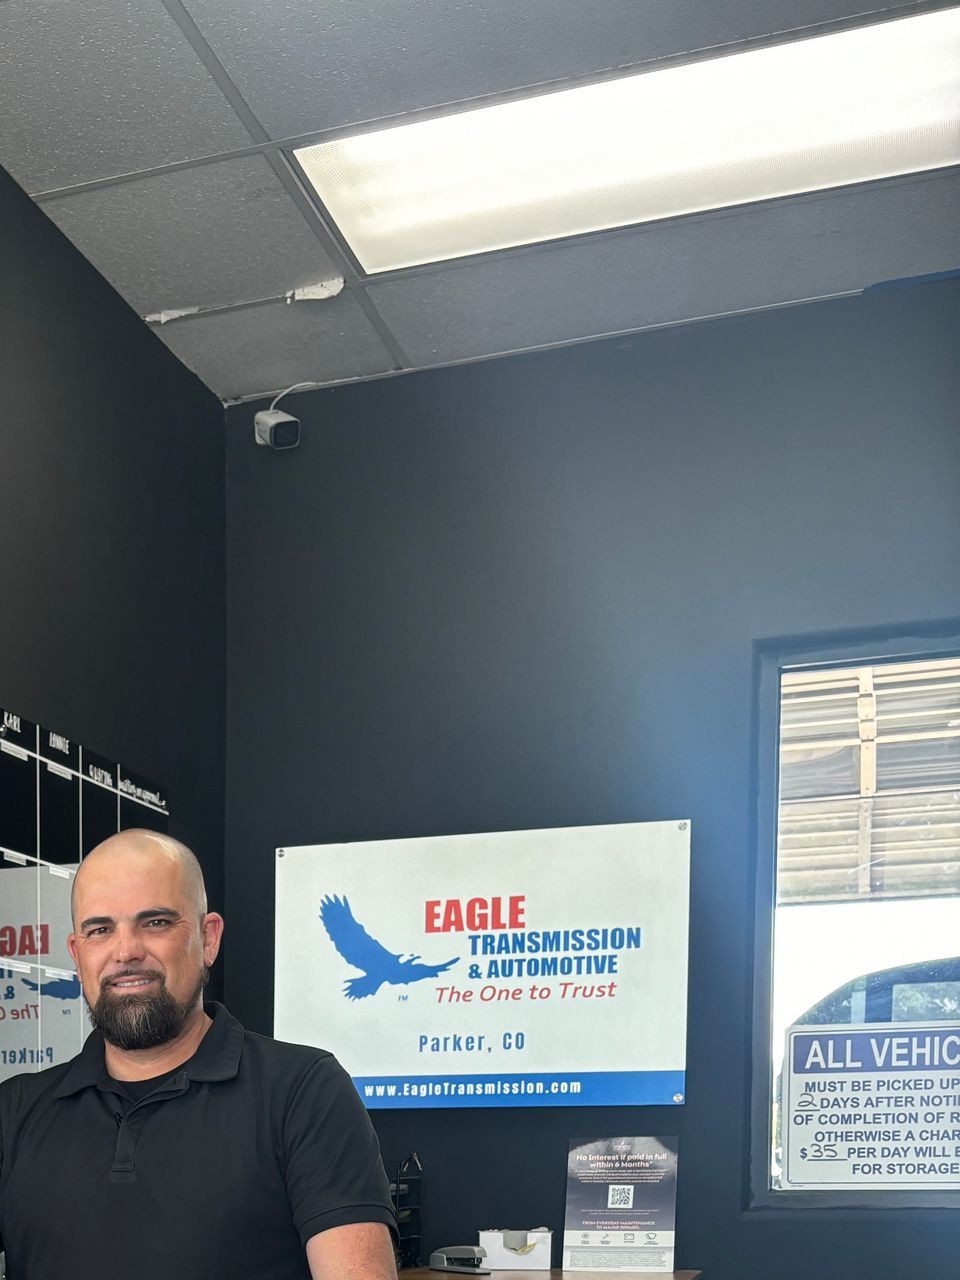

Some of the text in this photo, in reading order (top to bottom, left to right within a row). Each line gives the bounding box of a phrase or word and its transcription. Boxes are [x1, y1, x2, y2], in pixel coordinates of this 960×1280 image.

[424, 895, 526, 934] EAGLE
[468, 926, 642, 956] TRANSMISSION
[468, 954, 618, 979] & AUTOMOTIVE
[435, 981, 617, 1004] The One to Trust
[419, 1032, 525, 1053] Parker, CO
[804, 1035, 960, 1069] ALL VEHIC
[364, 1079, 583, 1098] www.EagleTransmission.com
[804, 1078, 960, 1093] MUST BE PICKED UP
[820, 1097, 860, 1109] DAYS
[864, 1095, 915, 1108] AFTER
[919, 1094, 960, 1107] NOTI
[793, 1114, 814, 1126] OF
[818, 1112, 919, 1125] COMPLETION
[923, 1112, 945, 1123] OF
[814, 1129, 960, 1142] OTHERWISE A CHAR
[588, 1153, 619, 1161] Interest
[627, 1152, 645, 1162] paid
[654, 1152, 668, 1160] full
[847, 1147, 876, 1158] PER
[881, 1147, 910, 1158] DAY
[914, 1146, 951, 1158] WILL
[852, 1163, 960, 1175] FOR STORAGE
